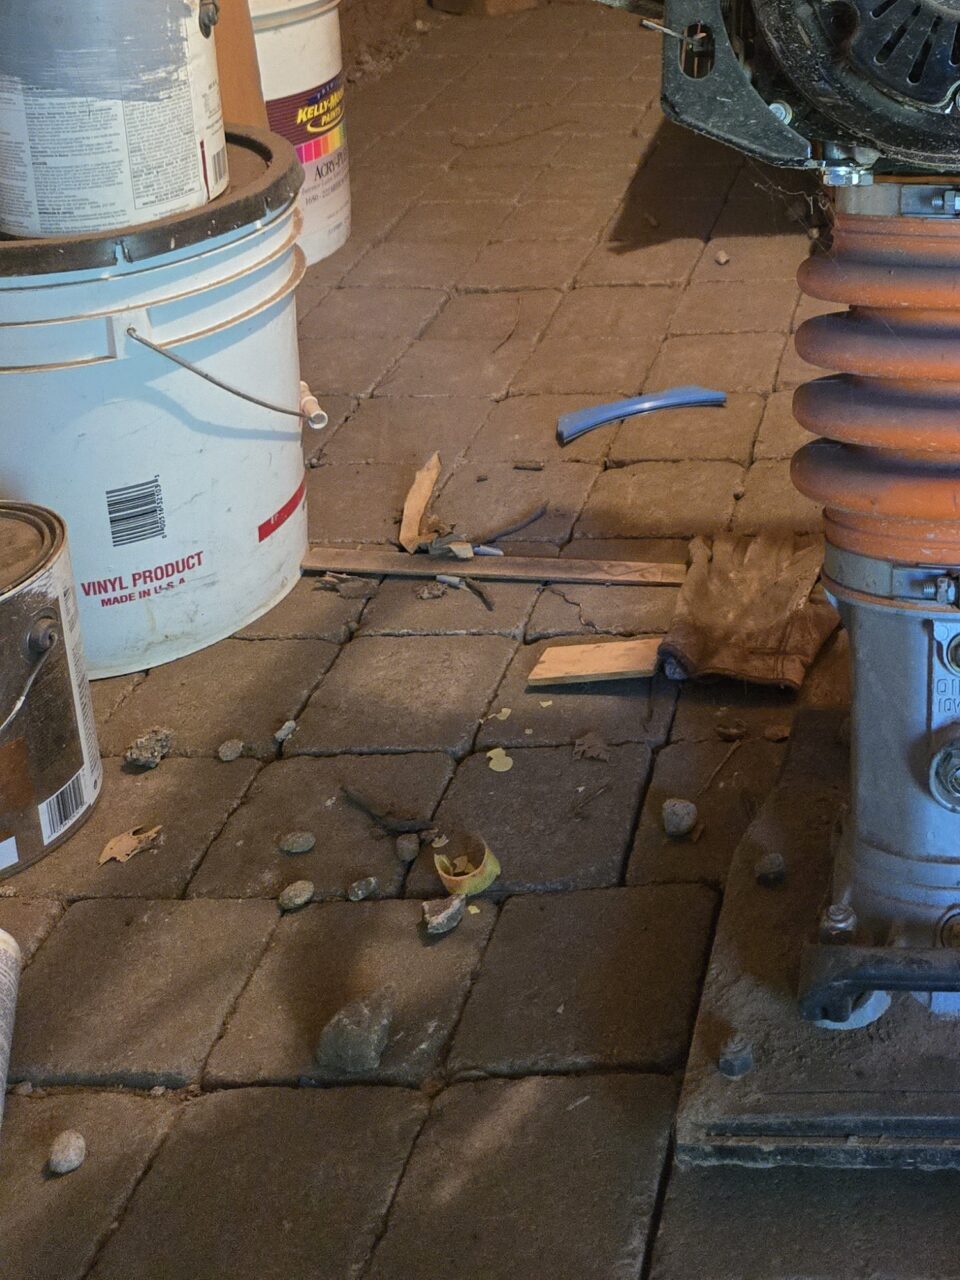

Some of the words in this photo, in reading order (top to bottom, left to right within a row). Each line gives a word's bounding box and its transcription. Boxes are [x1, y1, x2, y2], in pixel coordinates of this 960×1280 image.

[80, 576, 129, 599] VINYL
[131, 550, 204, 588] PRODUCT
[100, 592, 137, 607] MADE
[138, 587, 152, 600] IN
